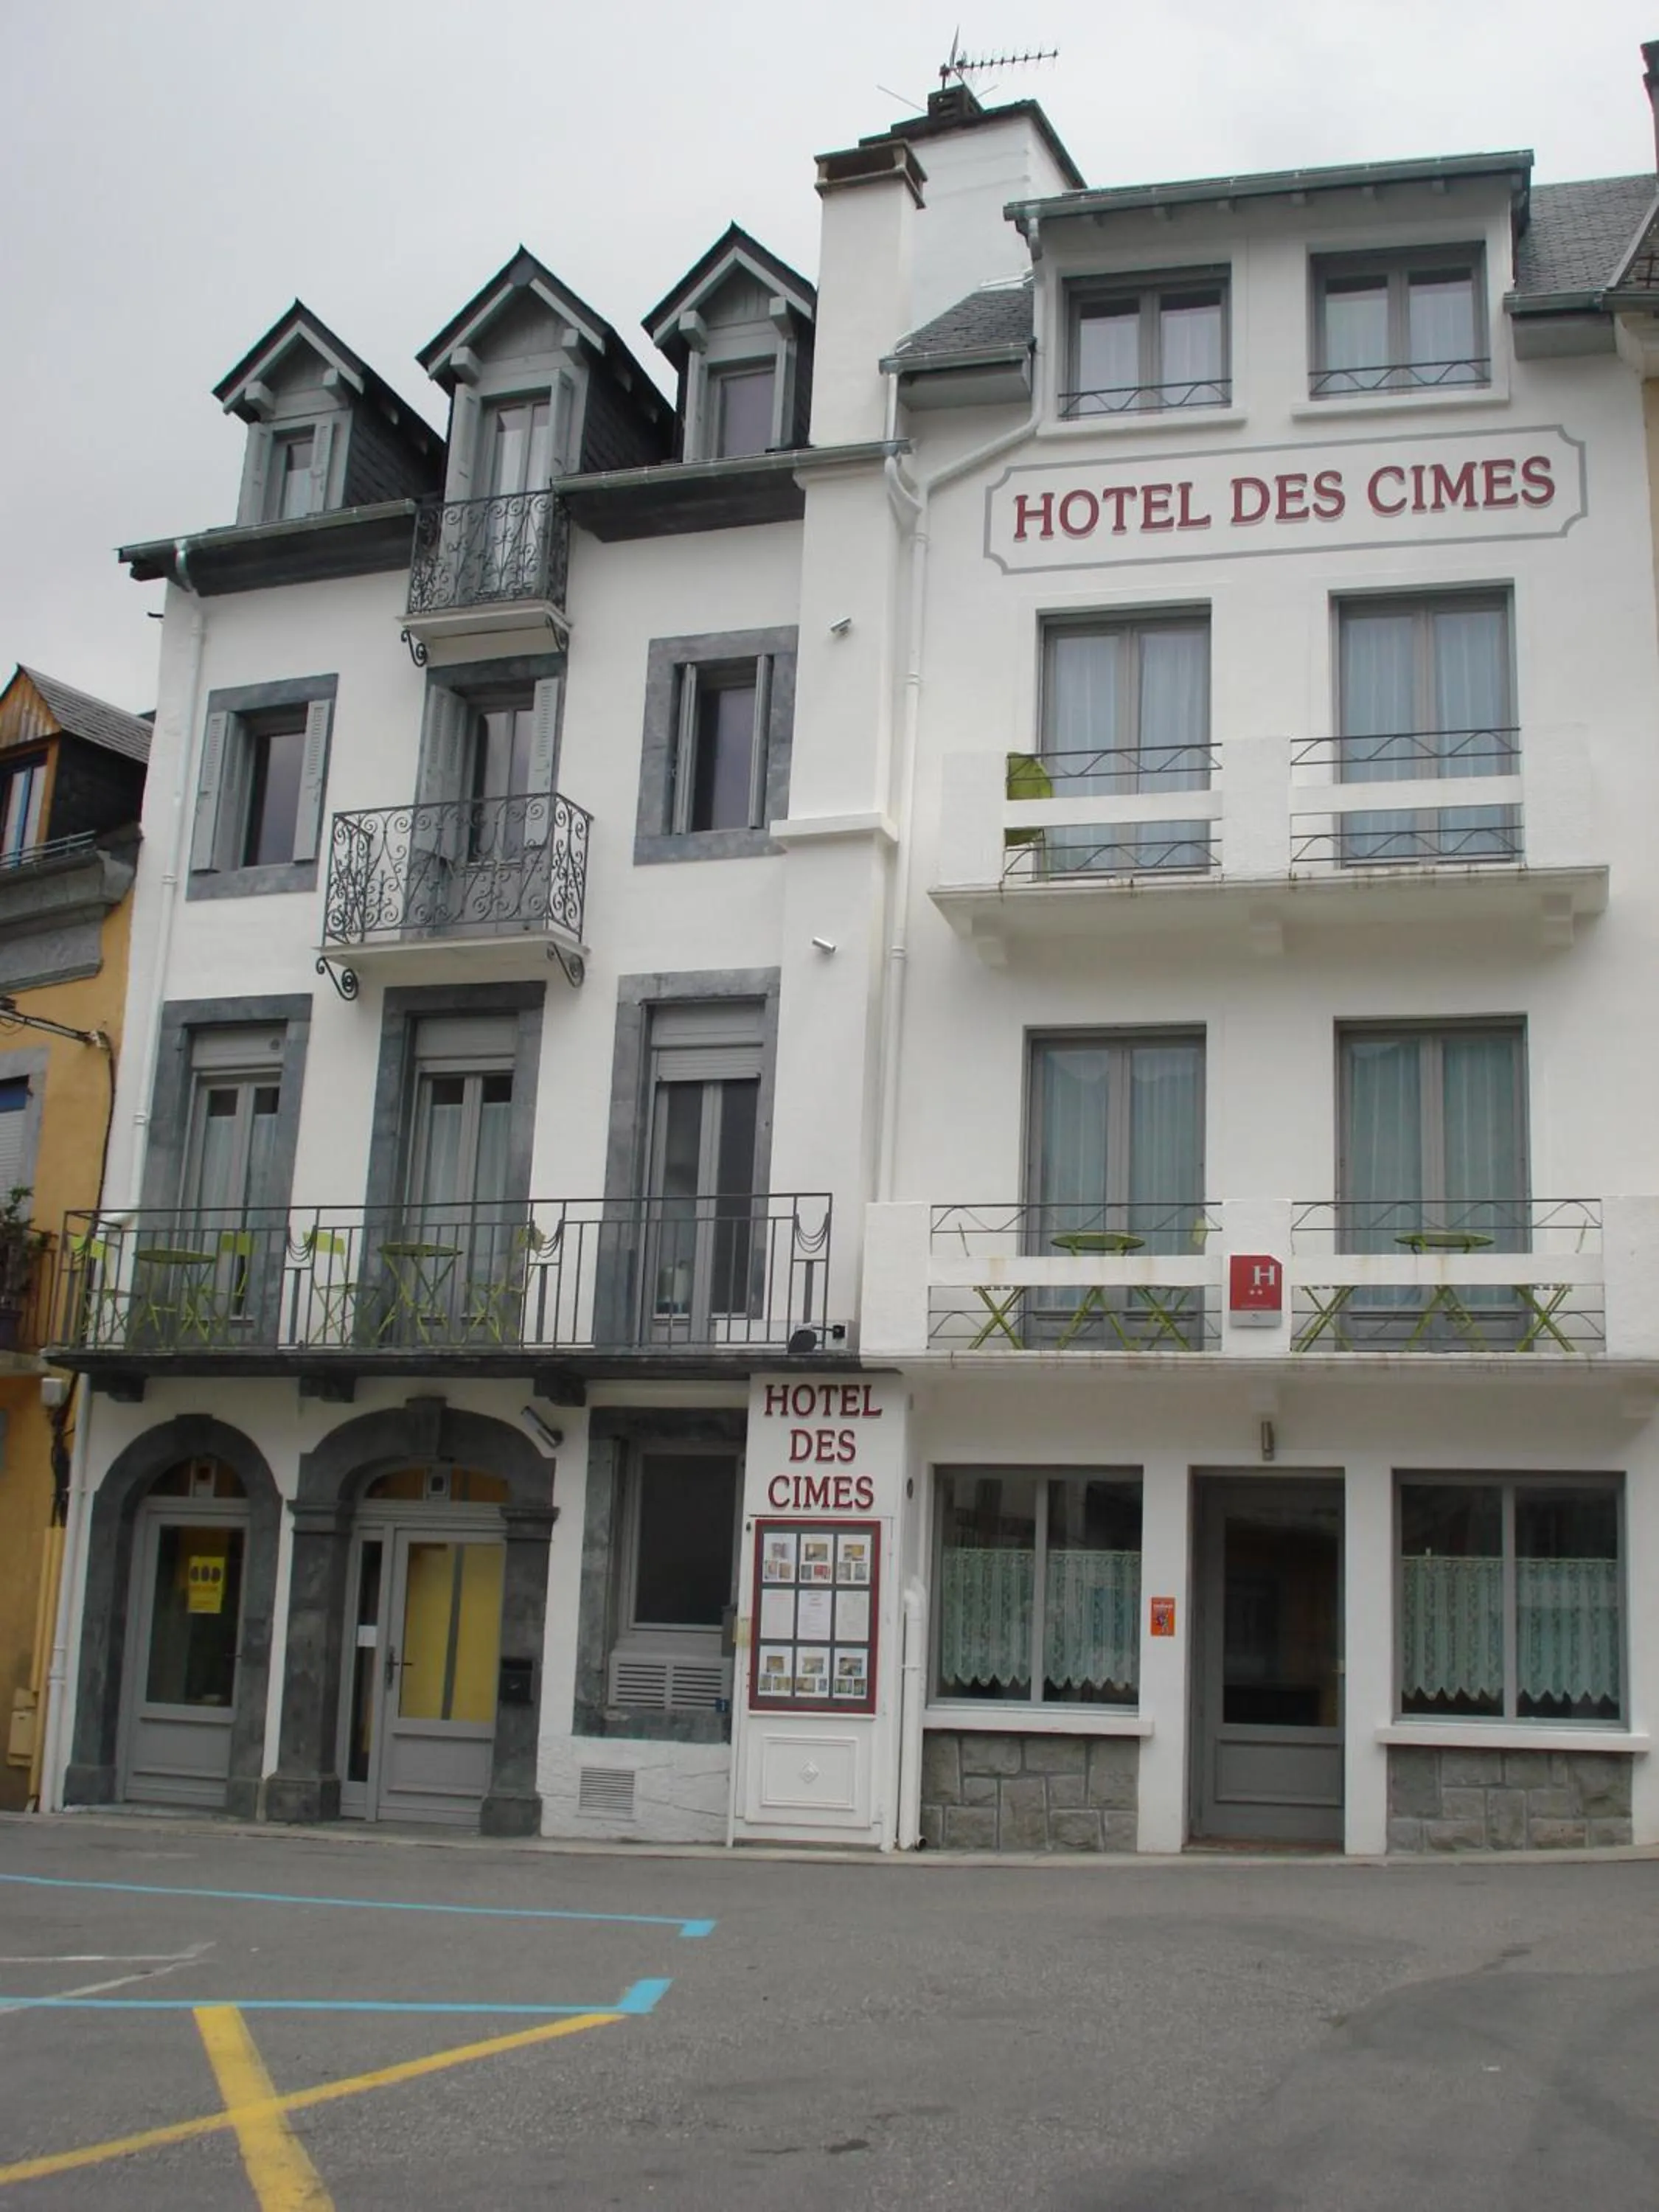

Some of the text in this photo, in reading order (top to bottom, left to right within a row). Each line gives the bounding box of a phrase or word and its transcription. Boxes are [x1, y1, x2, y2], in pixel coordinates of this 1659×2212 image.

[1013, 456, 1555, 540] HOTEL DES CIMES
[1253, 1265, 1274, 1285] H
[764, 1384, 883, 1416] HOTEL
[789, 1429, 856, 1462] DES
[768, 1475, 874, 1509] CIMES
